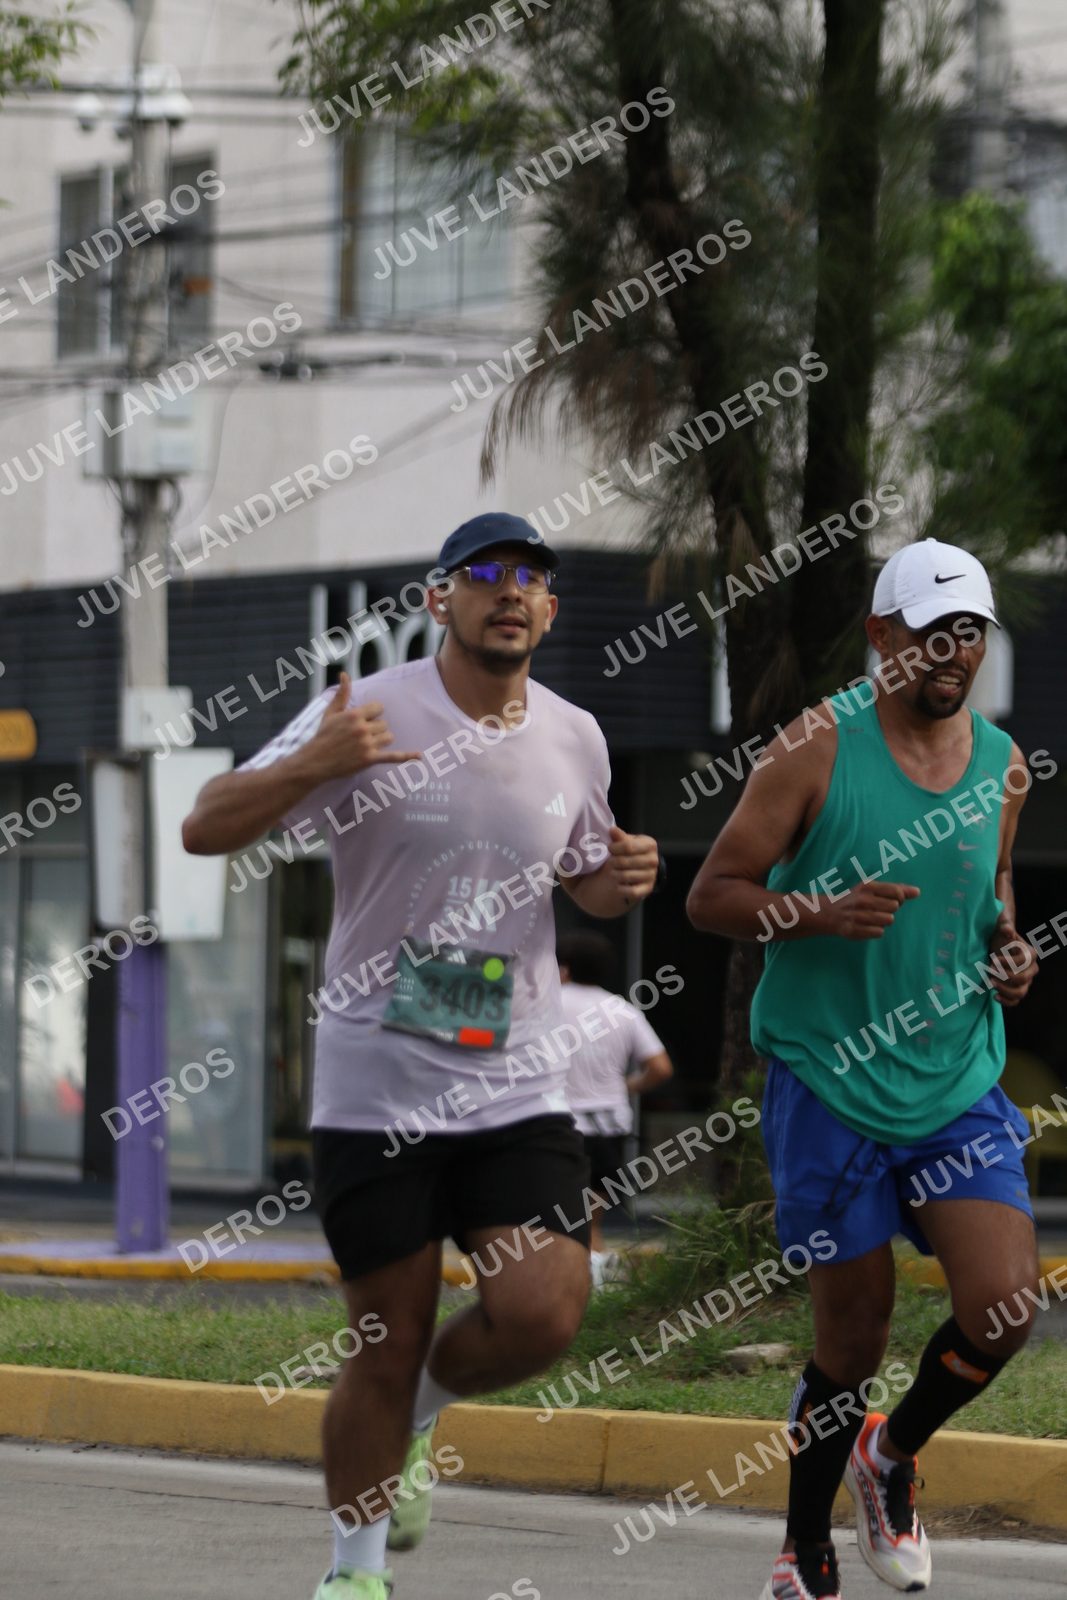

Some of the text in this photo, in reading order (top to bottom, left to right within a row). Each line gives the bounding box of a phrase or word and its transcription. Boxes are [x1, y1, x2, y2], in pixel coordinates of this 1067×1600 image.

[405, 813, 449, 822] SAMSUNG
[447, 875, 472, 898] 15
[420, 976, 505, 1021] 3403
